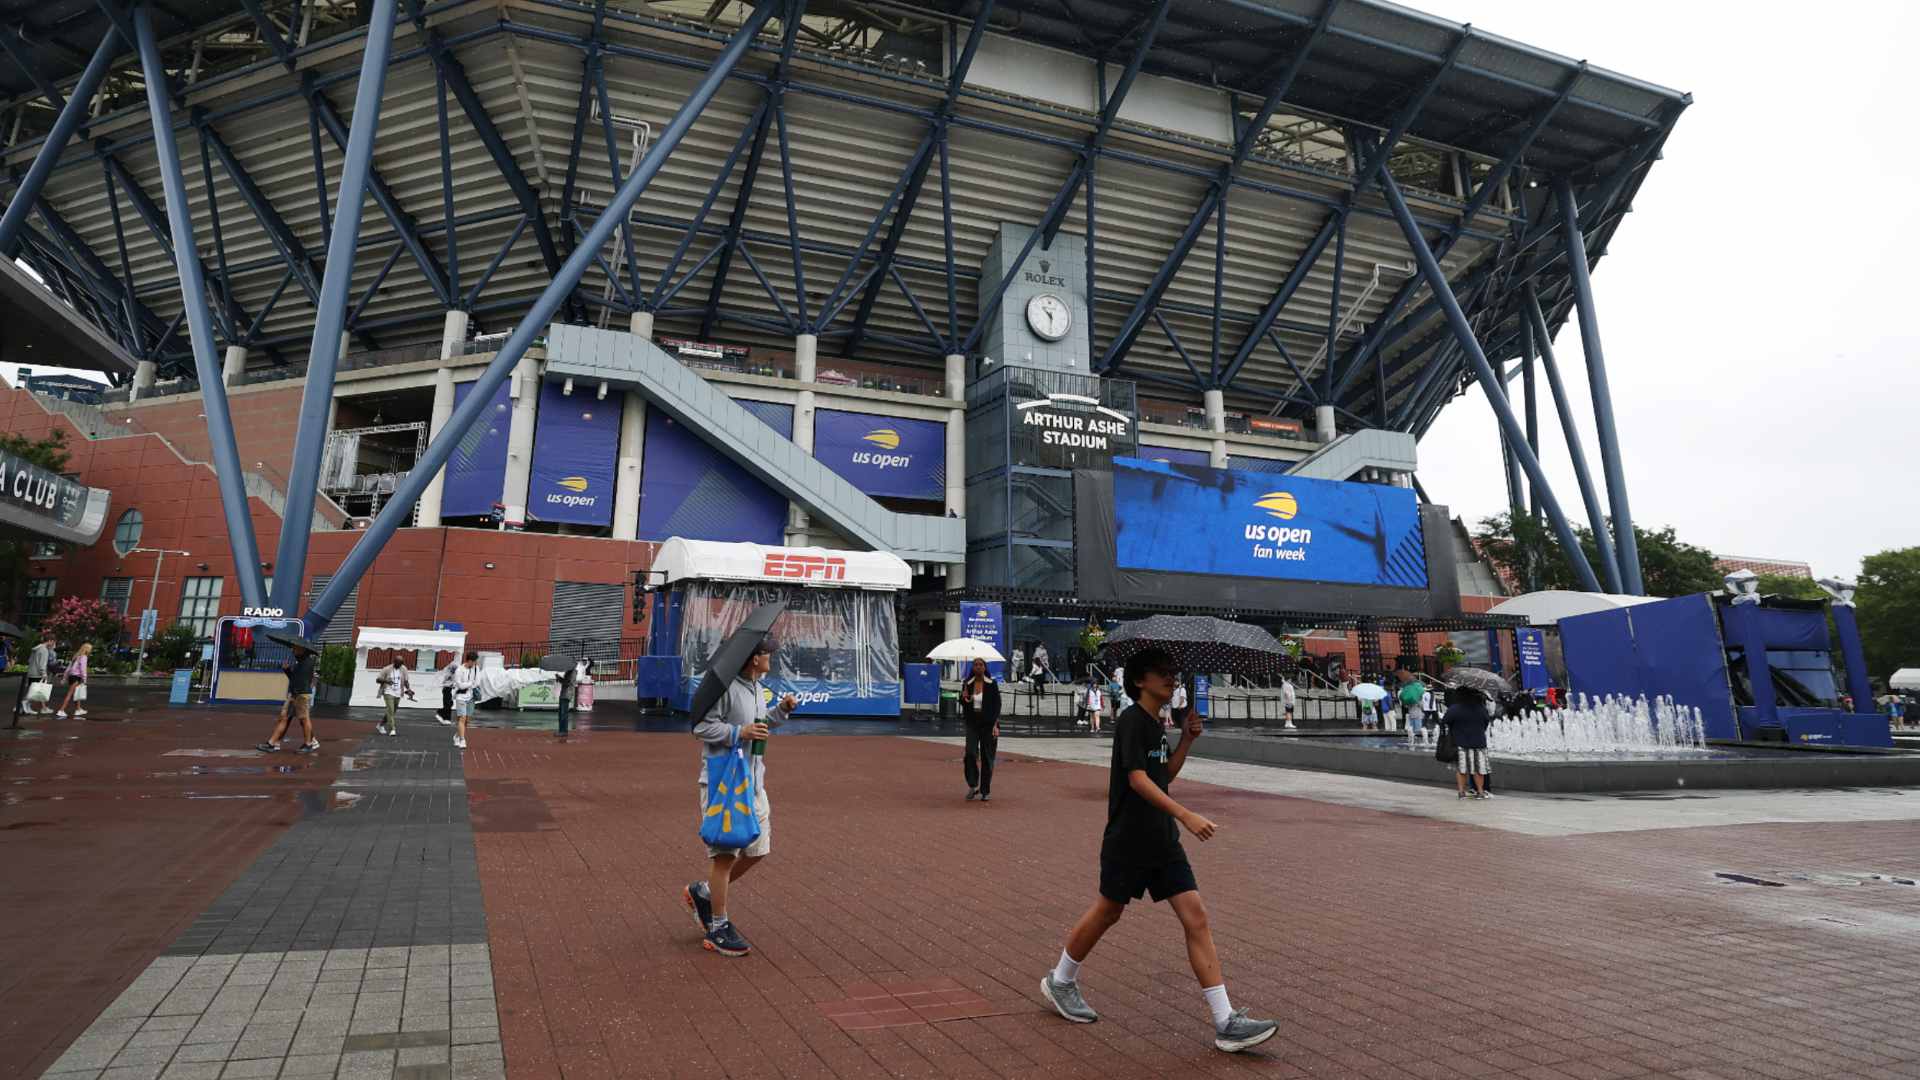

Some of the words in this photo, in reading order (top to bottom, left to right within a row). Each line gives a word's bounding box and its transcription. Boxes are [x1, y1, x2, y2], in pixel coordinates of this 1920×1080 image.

[1025, 271, 1065, 287] ROLEX
[1023, 410, 1083, 430] ARTHUR
[1088, 419, 1126, 435] ASHE
[1043, 430, 1107, 449] STADIUM
[852, 452, 871, 463] us
[872, 454, 909, 468] open
[13, 470, 57, 509] CLUB
[547, 494, 562, 503] us
[563, 495, 595, 507] open
[1245, 524, 1266, 539] us
[1267, 526, 1312, 547] open
[1253, 543, 1273, 559] fan
[1276, 547, 1306, 561] week
[764, 554, 846, 579] ESPN
[243, 607, 284, 617] RADIO
[796, 691, 829, 706] open
